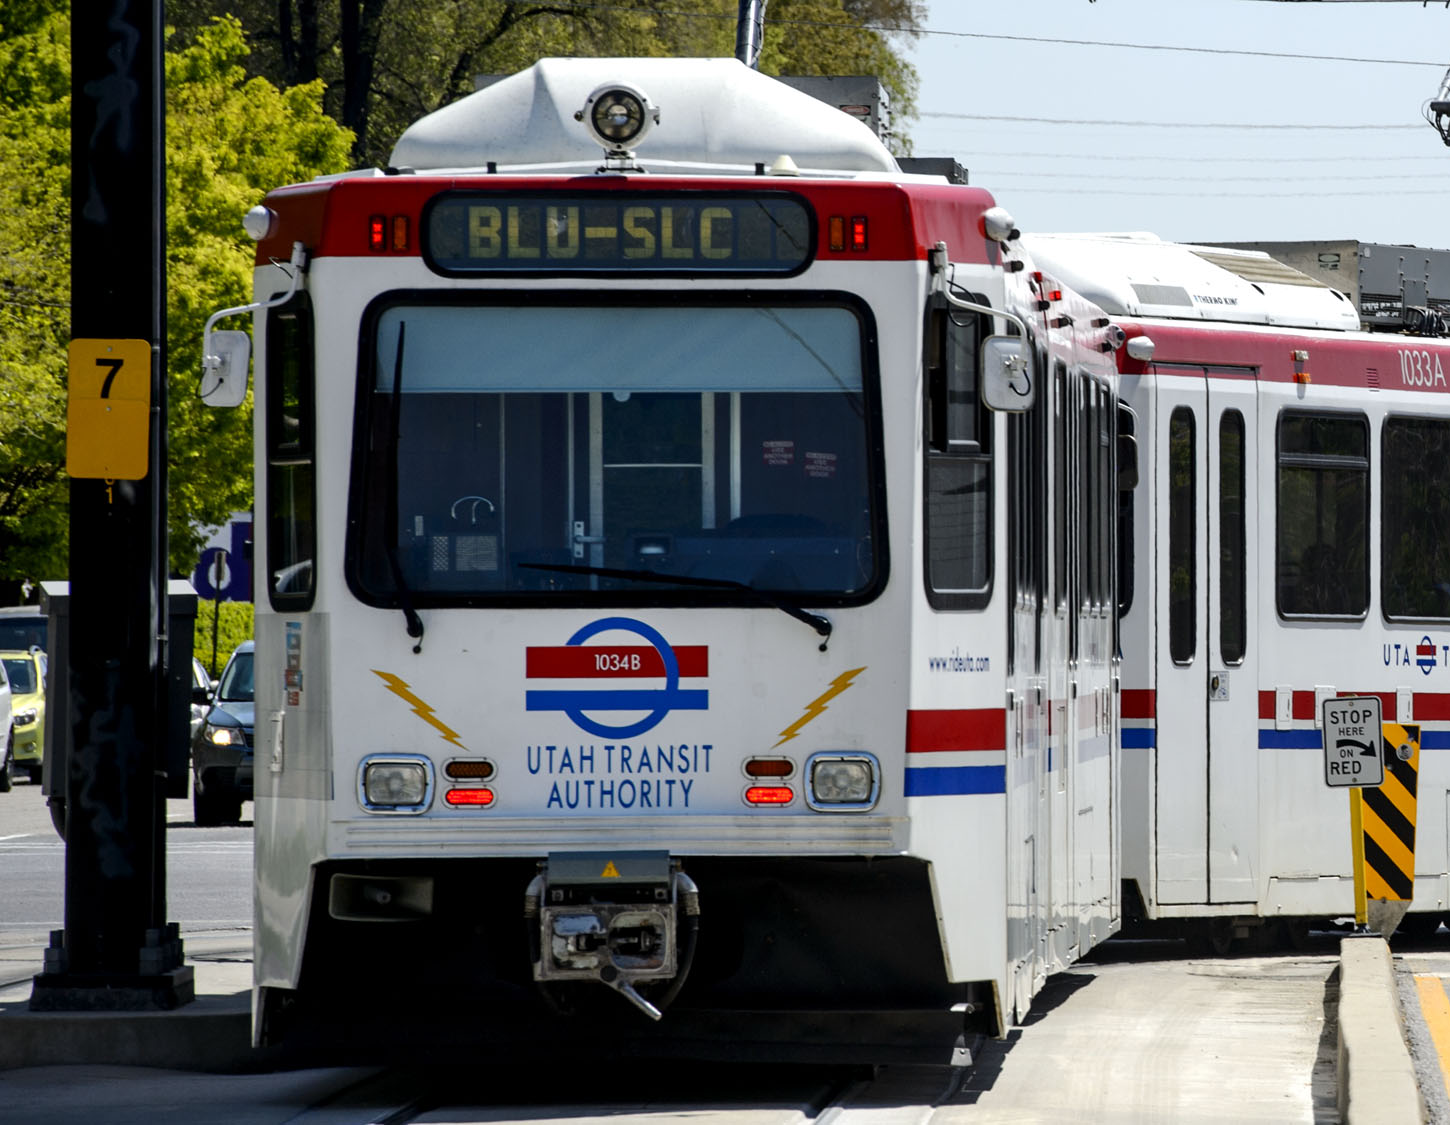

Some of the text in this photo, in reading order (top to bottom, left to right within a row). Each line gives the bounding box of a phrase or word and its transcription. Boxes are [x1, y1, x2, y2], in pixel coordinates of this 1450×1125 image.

[468, 206, 733, 259] BLU-SLC
[95, 358, 124, 399] 7
[1398, 349, 1447, 388] 1033A
[594, 654, 641, 671] 1034B
[928, 645, 990, 672] www.rideuta.com
[1383, 643, 1410, 667] UTA
[1330, 709, 1373, 725] STOP
[1338, 726, 1365, 737] HERE
[527, 744, 713, 775] UTAH TRANSIT
[1339, 748, 1354, 758] ON
[1330, 760, 1362, 775] RED
[547, 779, 693, 809] AUTHORITY
